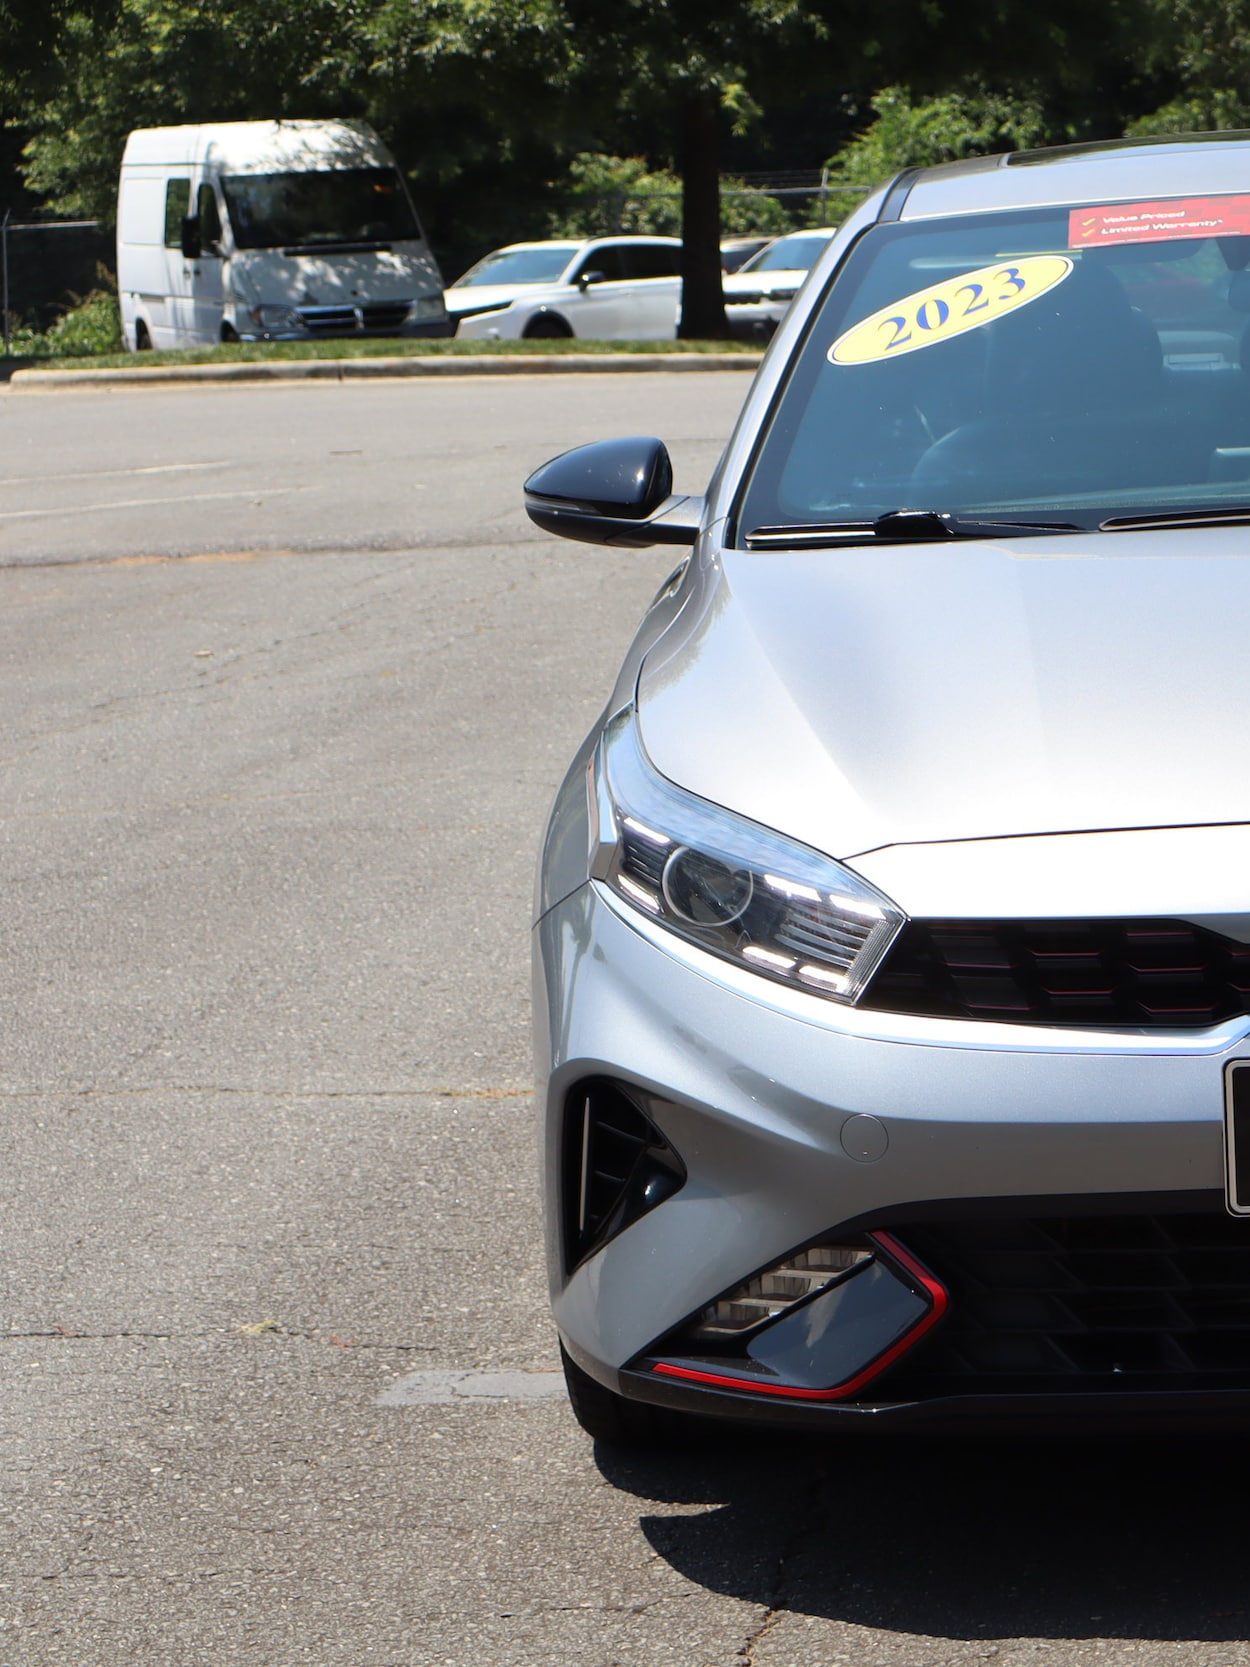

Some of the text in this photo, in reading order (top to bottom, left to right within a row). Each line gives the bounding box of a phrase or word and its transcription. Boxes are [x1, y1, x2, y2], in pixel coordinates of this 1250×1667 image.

[1103, 211, 1185, 223] Value Priced
[1101, 224, 1150, 235] Limited
[876, 267, 1027, 351] 2023
